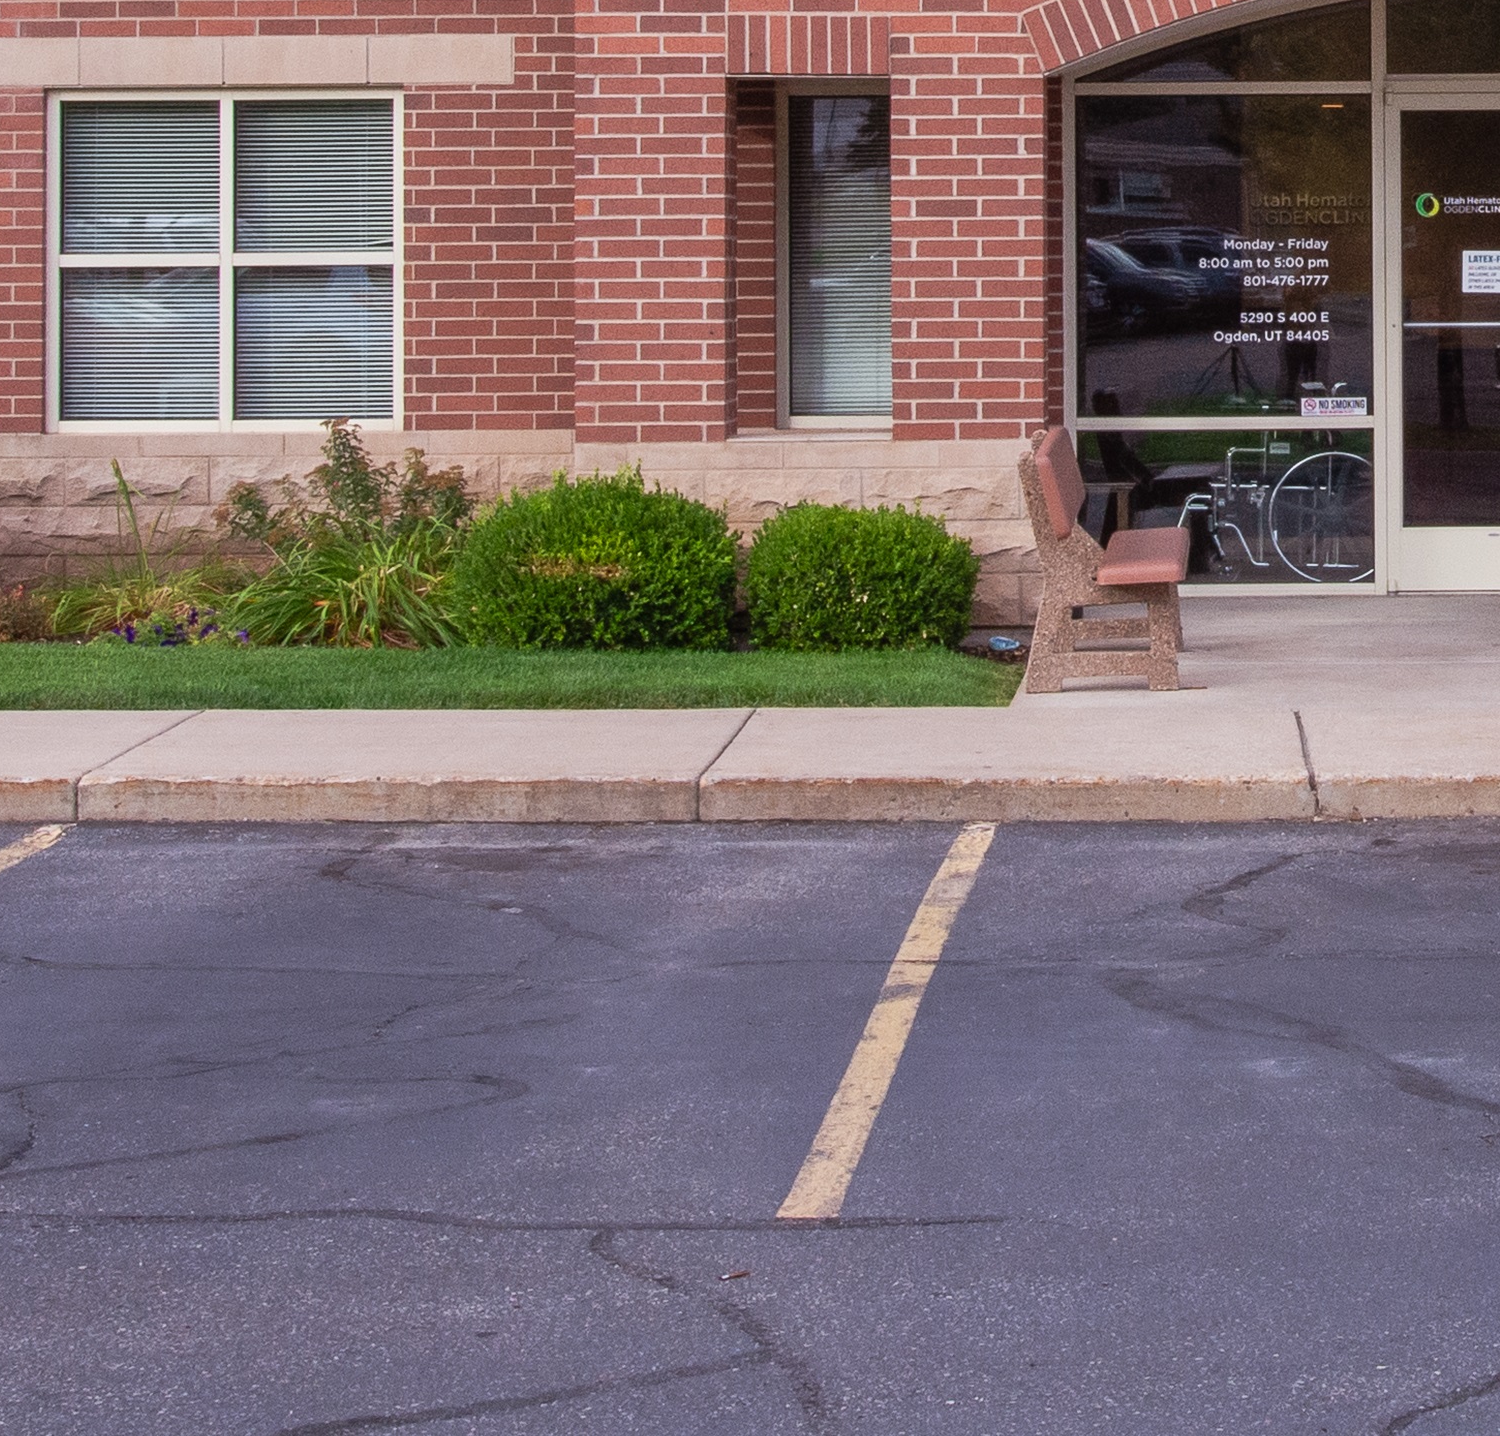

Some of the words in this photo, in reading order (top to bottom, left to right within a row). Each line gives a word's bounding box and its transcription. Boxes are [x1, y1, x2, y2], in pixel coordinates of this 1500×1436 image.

[1443, 196, 1465, 205] Utah
[1224, 238, 1275, 251] Monday
[1287, 238, 1329, 251] Friday
[1198, 257, 1229, 268] 8:00
[1233, 259, 1253, 268] am
[1256, 258, 1270, 268] to
[1274, 257, 1304, 268] 5:00
[1308, 258, 1329, 269] pm
[1243, 275, 1329, 286] 801-476-1777
[1240, 312, 1274, 323] 5290
[1277, 312, 1285, 323] S
[1289, 312, 1317, 323] 400
[1320, 311, 1329, 323] E
[1213, 330, 1260, 343] Ogden,
[1264, 330, 1282, 341] UT
[1286, 330, 1329, 341] 84405
[1318, 399, 1329, 409] NO
[1331, 399, 1365, 409] SMOKING
